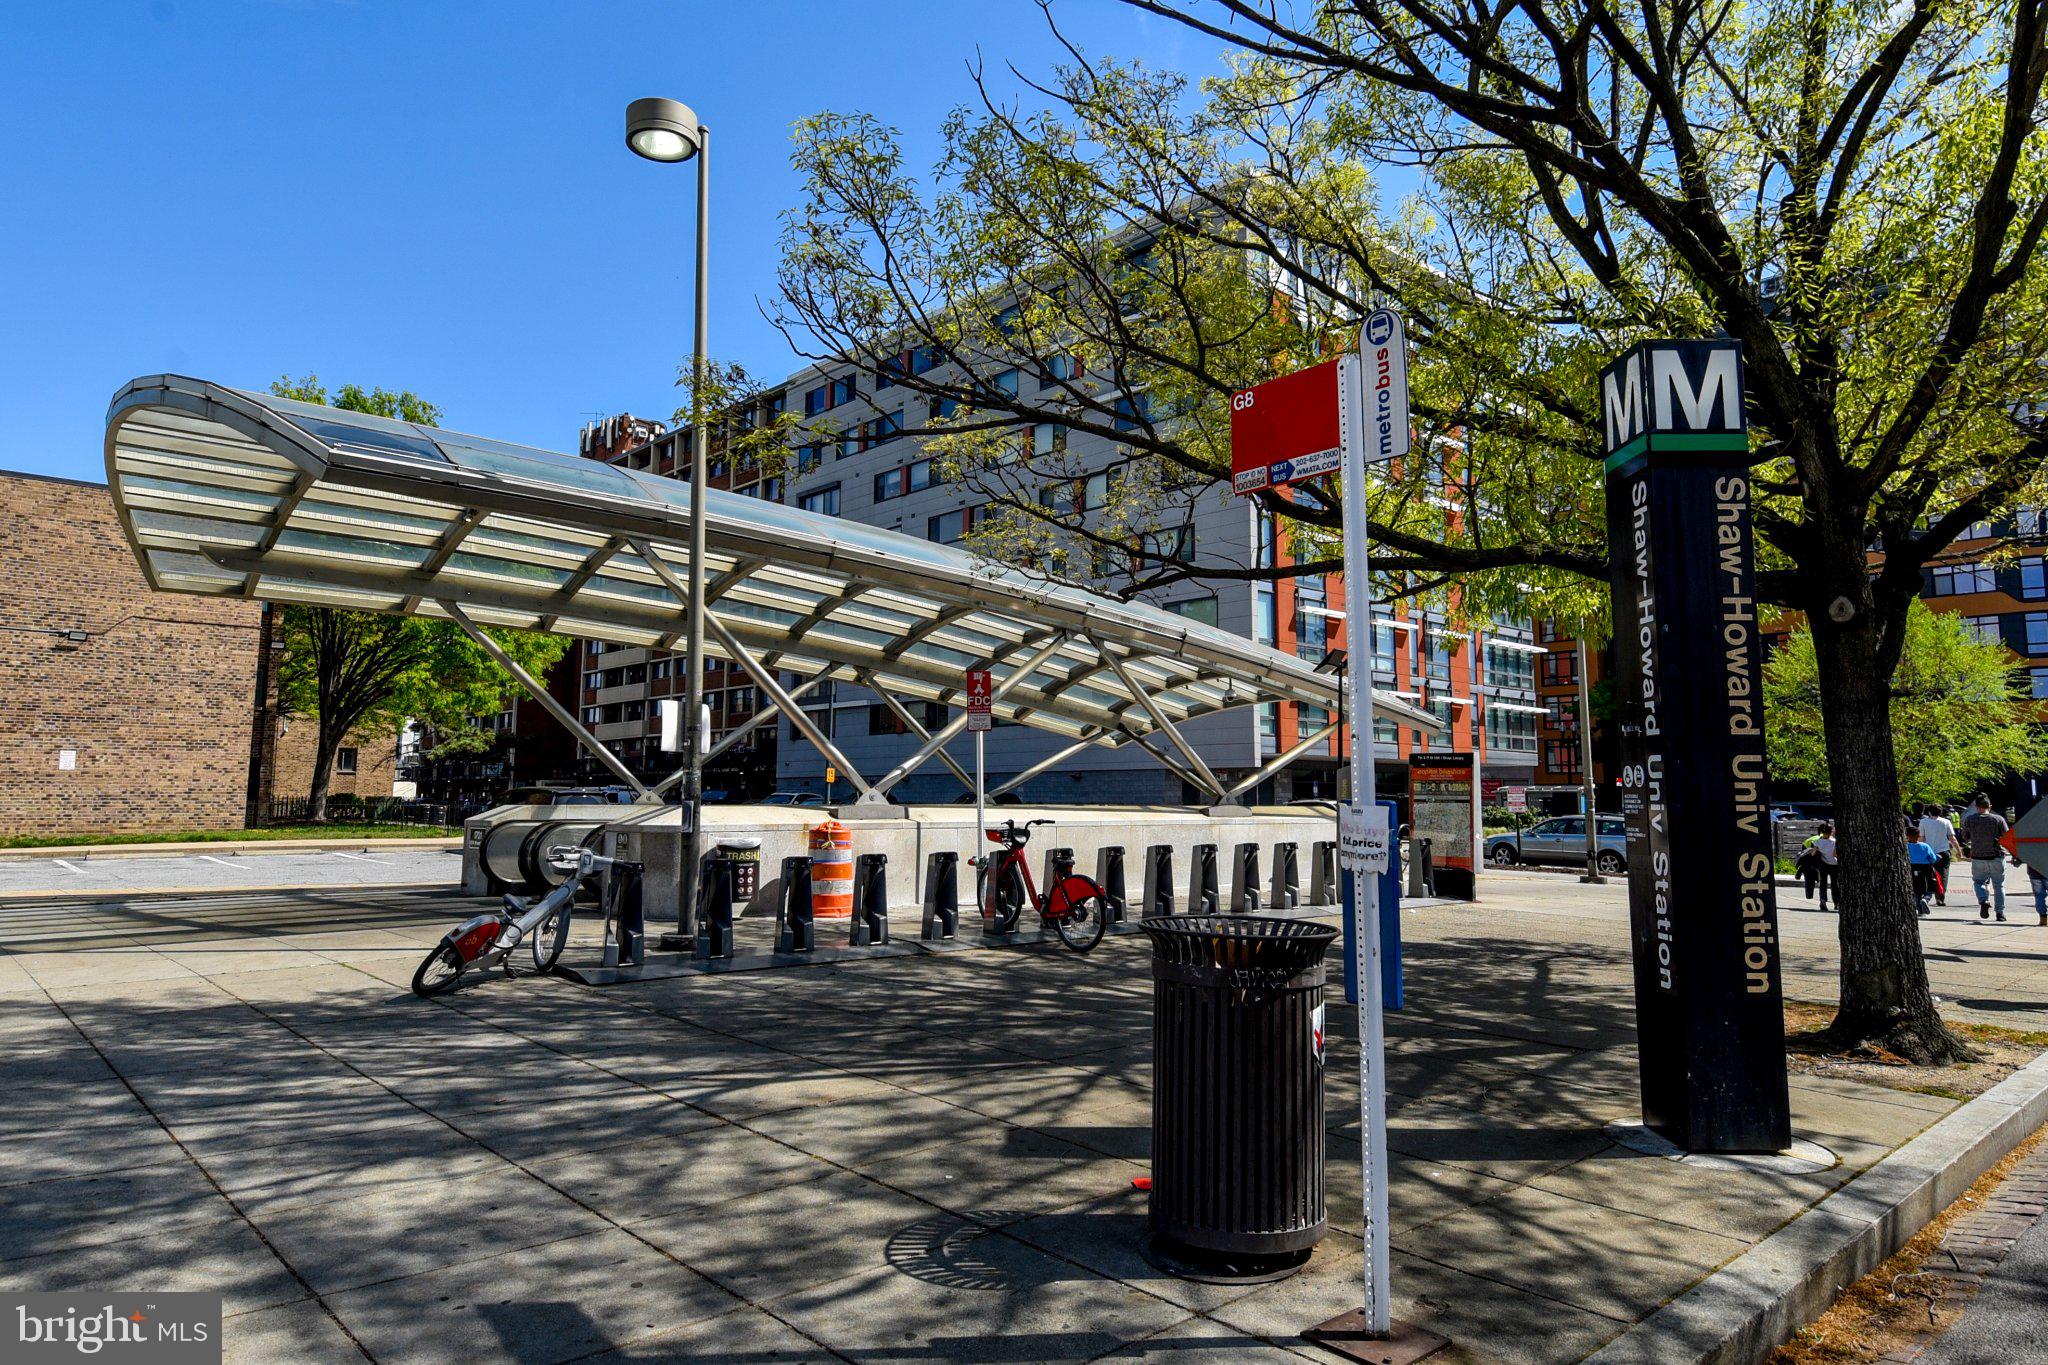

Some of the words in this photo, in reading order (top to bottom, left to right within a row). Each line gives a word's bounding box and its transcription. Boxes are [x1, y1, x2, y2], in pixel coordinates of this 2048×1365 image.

[1233, 391, 1254, 411] G8
[1375, 347, 1392, 455] metrobus
[1604, 352, 1645, 452] M
[1651, 349, 1741, 430] M
[1235, 472, 1250, 482] STOP
[1271, 462, 1288, 473] NEXT
[1272, 473, 1287, 483] BUS
[1295, 449, 1339, 467] 202-637-7000
[1295, 460, 1339, 476] WMATA.COM
[1632, 480, 1660, 736] Shaw-Howard
[1715, 476, 1761, 735] Shaw-Howard
[968, 695, 991, 705] FDC
[1647, 754, 1664, 834] Univ
[1731, 754, 1766, 835] Univ
[1653, 851, 1673, 990] Station
[1738, 852, 1774, 994] Station
